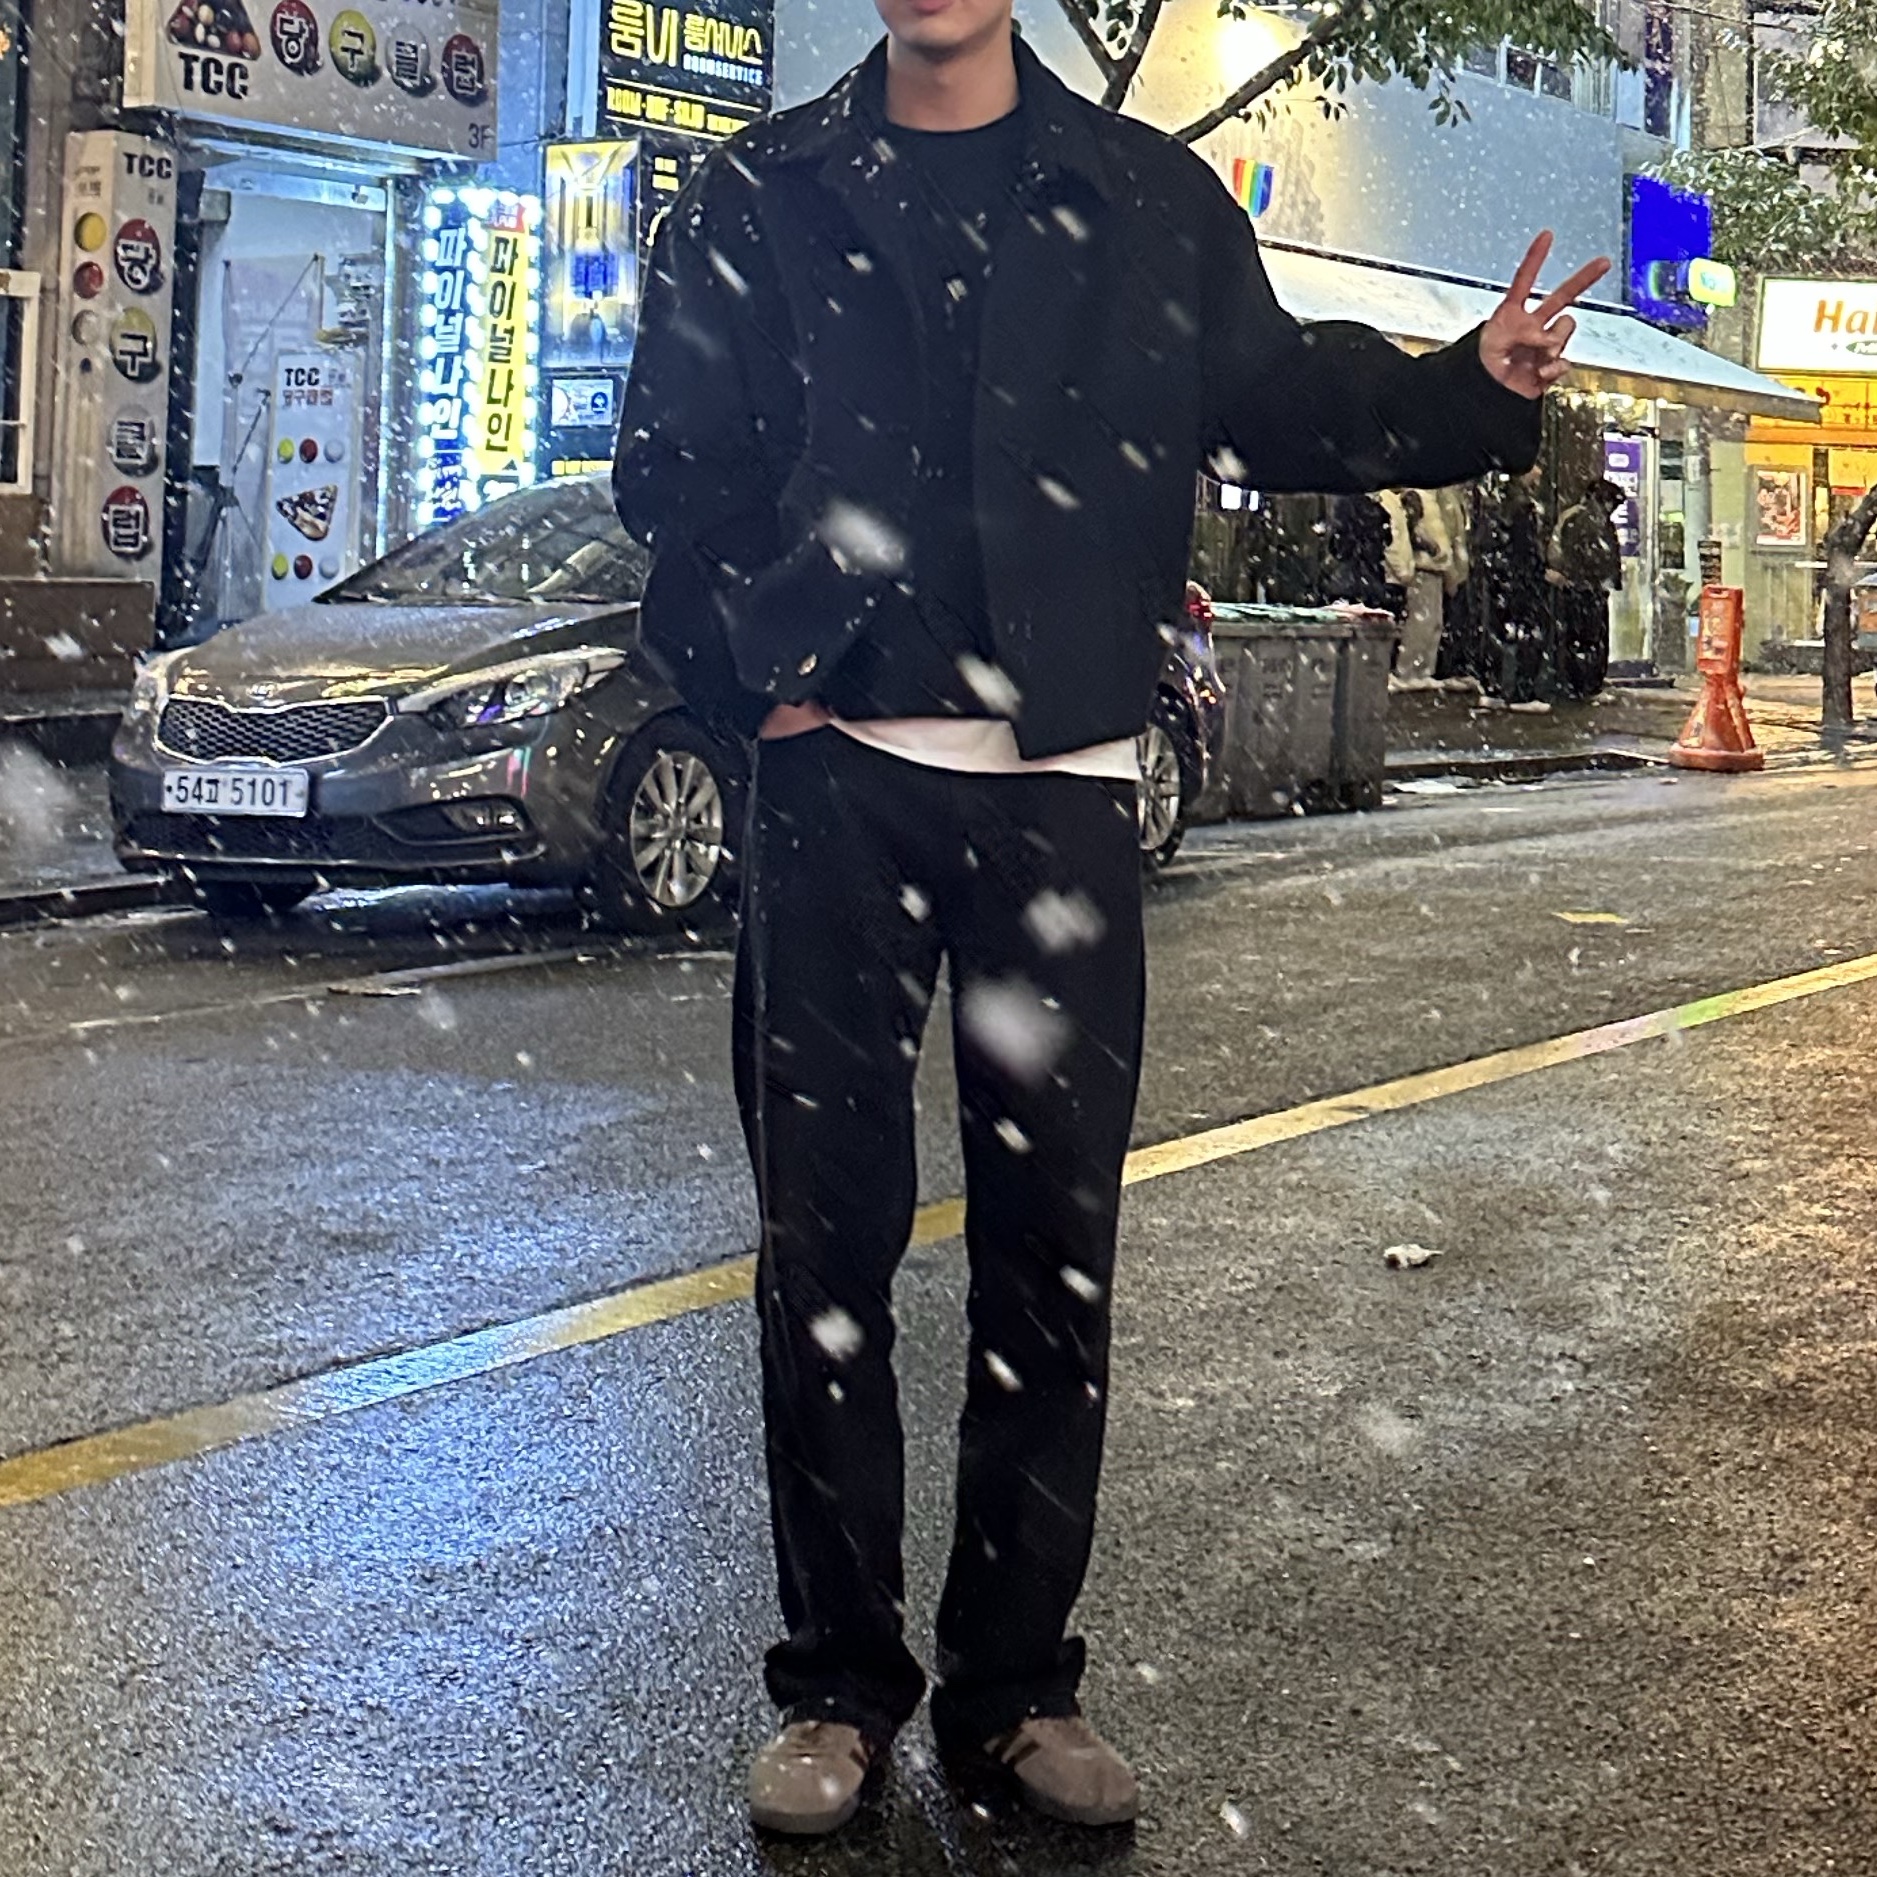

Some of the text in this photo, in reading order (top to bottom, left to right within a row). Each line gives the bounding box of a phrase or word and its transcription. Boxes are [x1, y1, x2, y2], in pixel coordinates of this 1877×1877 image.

[178, 52, 249, 100] TCC
[123, 153, 172, 179] TCC
[430, 227, 467, 441] 파이널나인
[1814, 299, 1877, 335] Ha
[485, 236, 519, 453] 파이널나인
[284, 367, 320, 387] TCC
[229, 777, 289, 807] 5101
